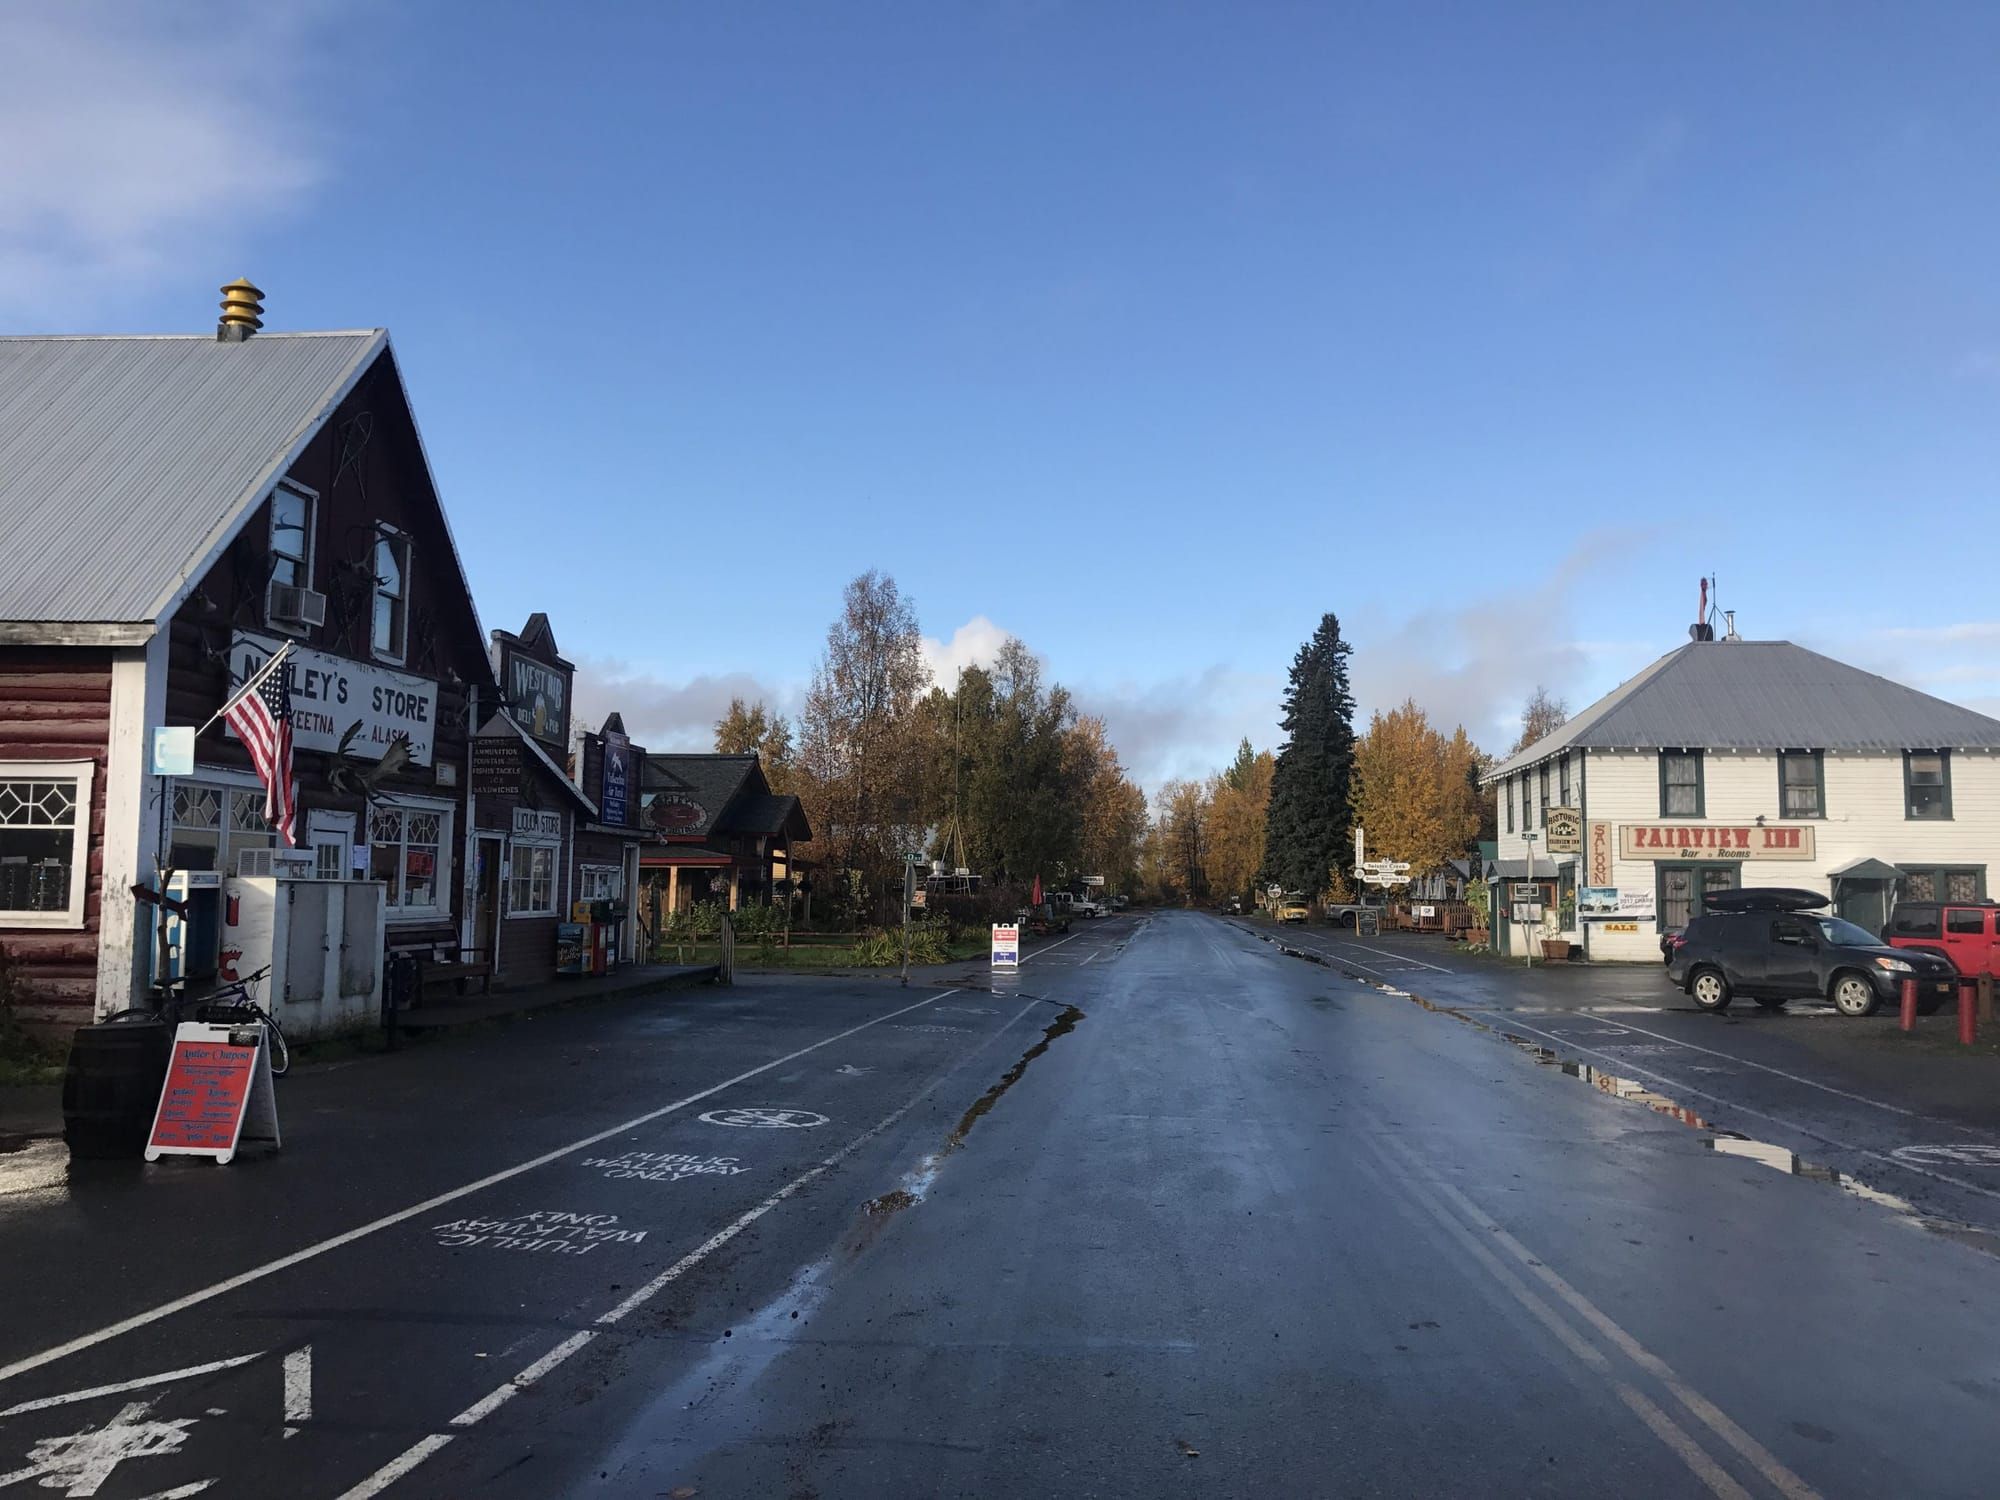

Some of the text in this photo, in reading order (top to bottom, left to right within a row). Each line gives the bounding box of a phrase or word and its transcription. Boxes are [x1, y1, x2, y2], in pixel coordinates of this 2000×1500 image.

[243, 654, 430, 723] NLEY'S STORE
[515, 661, 546, 698] WEST
[541, 815, 560, 834] STORE
[1548, 812, 1580, 825] HISTORIC
[1634, 828, 1801, 848] FAIRVIEW INN
[1594, 825, 1606, 884] SALOON
[1681, 849, 1752, 858] Bar Rooms
[580, 1158, 753, 1175] WALKWAY
[619, 1152, 740, 1166] PUBLIC
[603, 1169, 695, 1181] ONLY
[511, 1211, 620, 1225] ONLY
[432, 1217, 648, 1243] WALKWAY
[437, 1233, 600, 1255] PUBLIC
